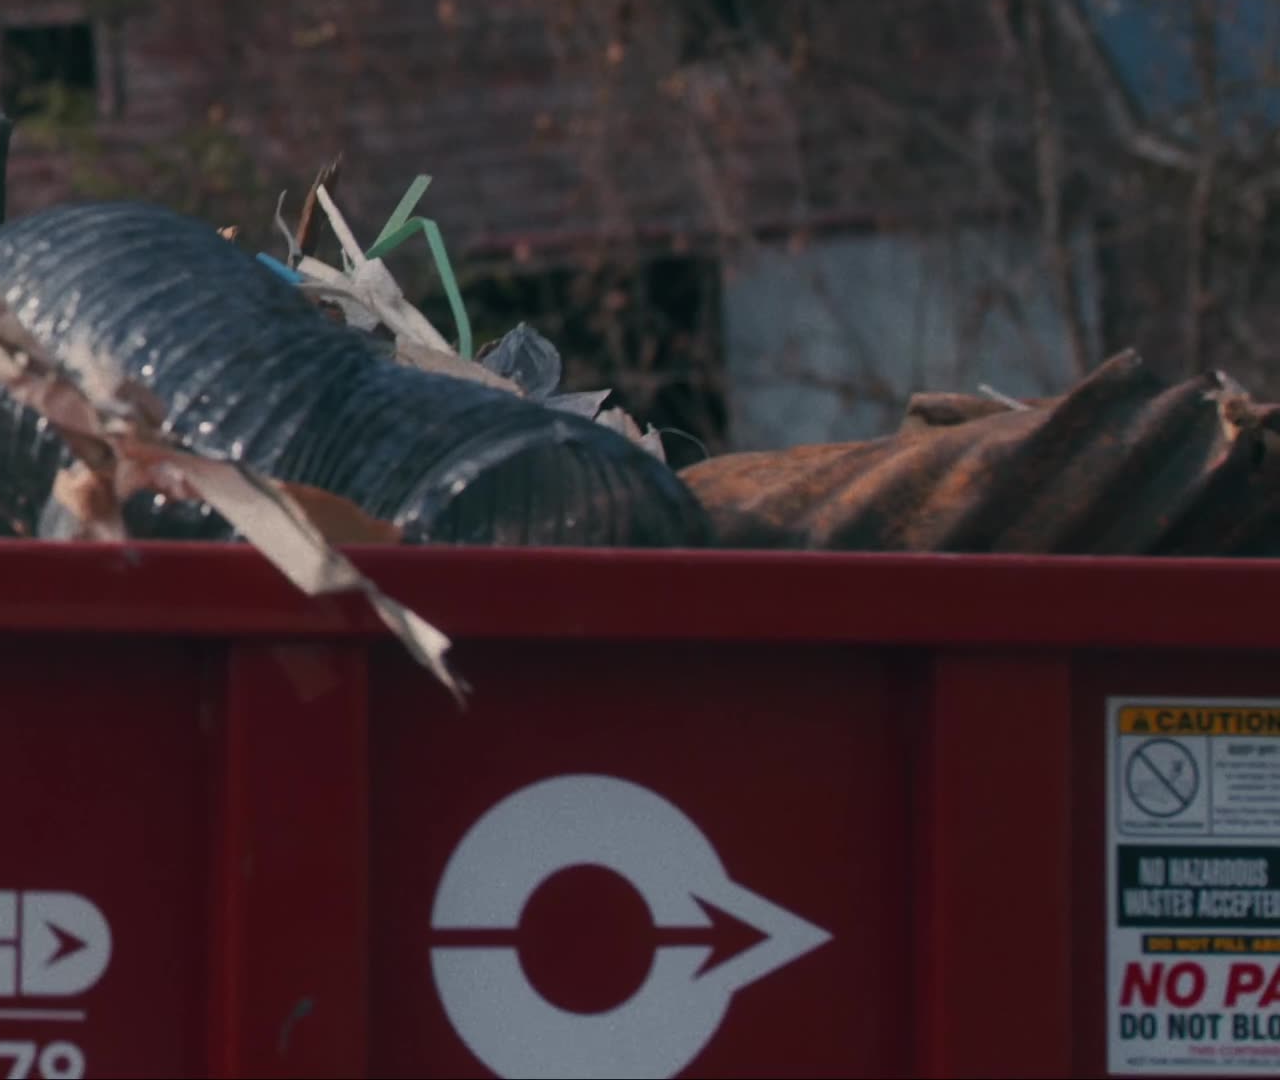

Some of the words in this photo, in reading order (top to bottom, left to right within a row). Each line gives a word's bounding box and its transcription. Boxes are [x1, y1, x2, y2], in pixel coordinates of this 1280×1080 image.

[1156, 711, 1280, 731] CAUTION
[1139, 857, 1165, 886] NO
[1168, 857, 1269, 888] HAZARDOUS
[1120, 961, 1207, 1008] NO
[1120, 1013, 1158, 1040] DO
[1168, 1013, 1224, 1040] NOT
[1231, 1014, 1280, 1040] BLO
